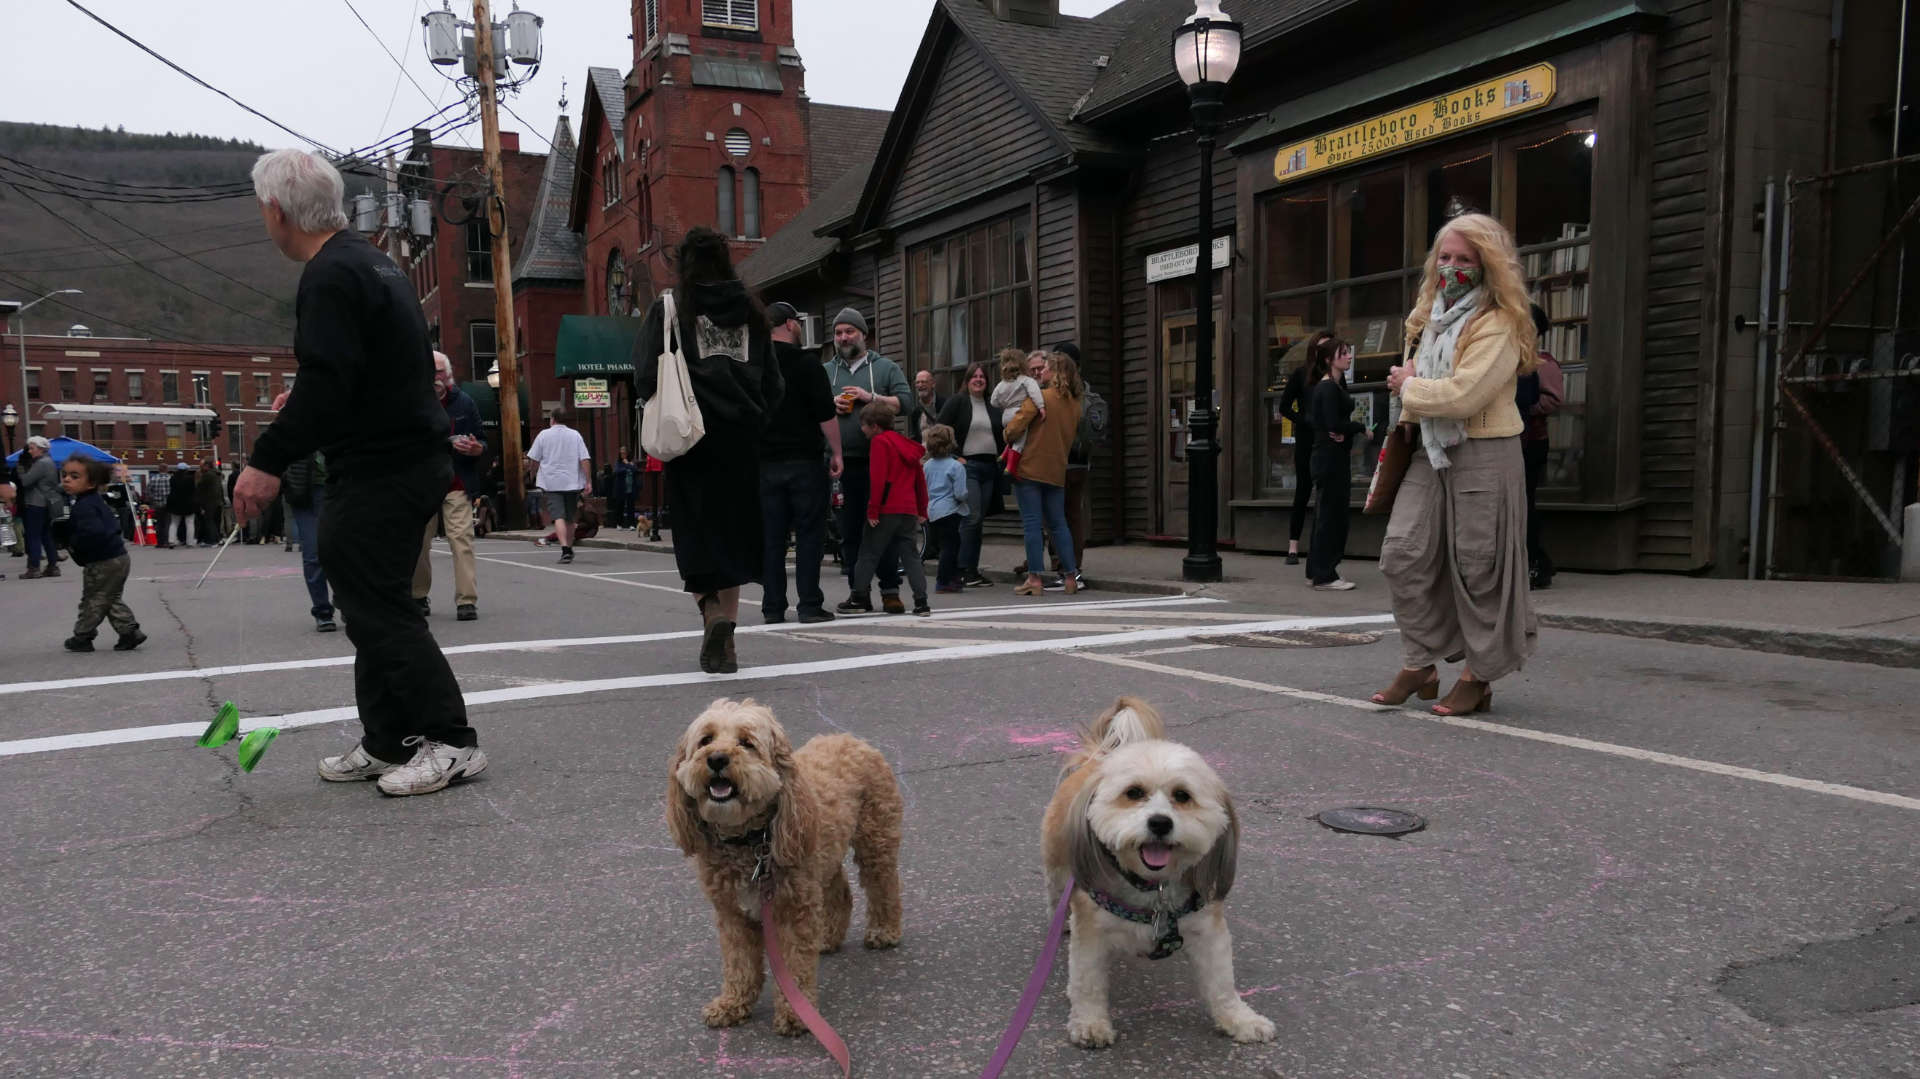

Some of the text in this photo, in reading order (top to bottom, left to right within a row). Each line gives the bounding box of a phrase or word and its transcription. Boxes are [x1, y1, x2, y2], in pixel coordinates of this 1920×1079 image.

[1313, 86, 1497, 157] Brattleboro Books
[1327, 111, 1481, 164] Over 25,000 Used Books
[1151, 247, 1198, 265] BRATTLEBORO
[578, 363, 605, 371] HOTEL
